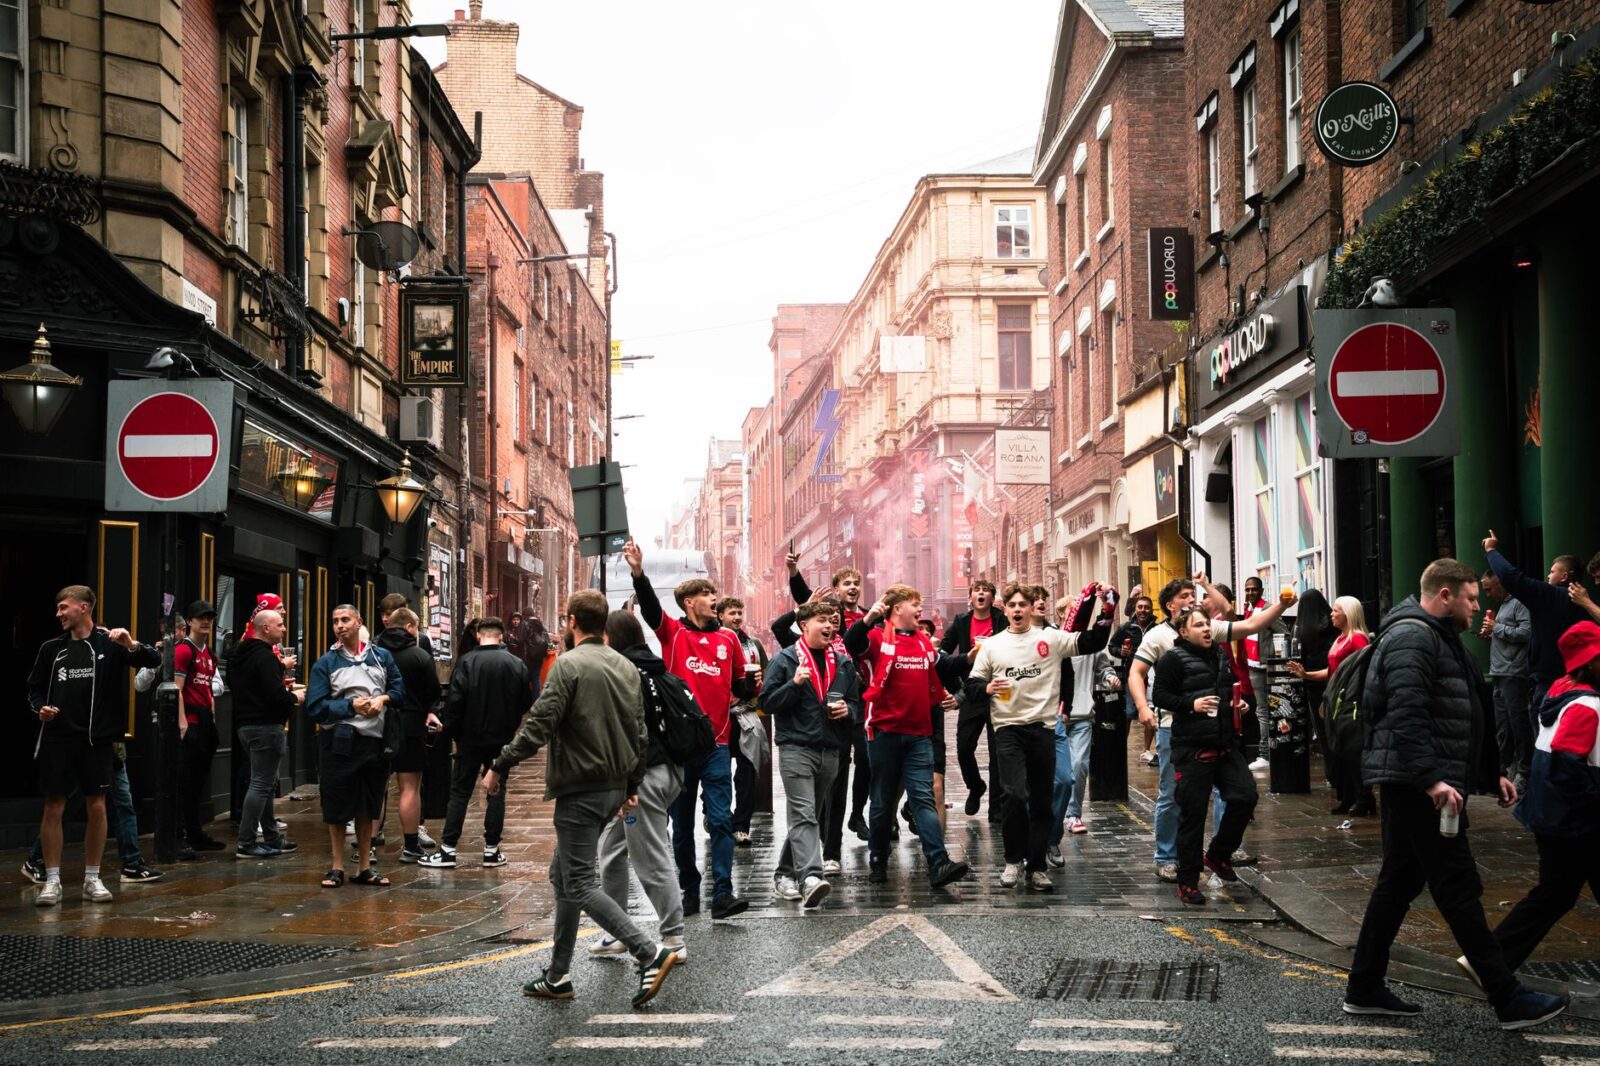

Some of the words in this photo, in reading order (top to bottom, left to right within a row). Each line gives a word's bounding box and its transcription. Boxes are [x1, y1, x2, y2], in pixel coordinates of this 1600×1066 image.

[1323, 102, 1391, 139] O'Neill's
[1331, 140, 1345, 152] EAT
[1350, 145, 1376, 156] DRINK
[1379, 120, 1393, 145] ENJOY
[408, 350, 422, 361] THE
[413, 360, 455, 375] EMPIRE
[1008, 443, 1038, 452] VILLA
[685, 656, 721, 676] Carlsberg
[894, 662, 924, 670] Chartered
[1005, 664, 1042, 681] Carlsberg
